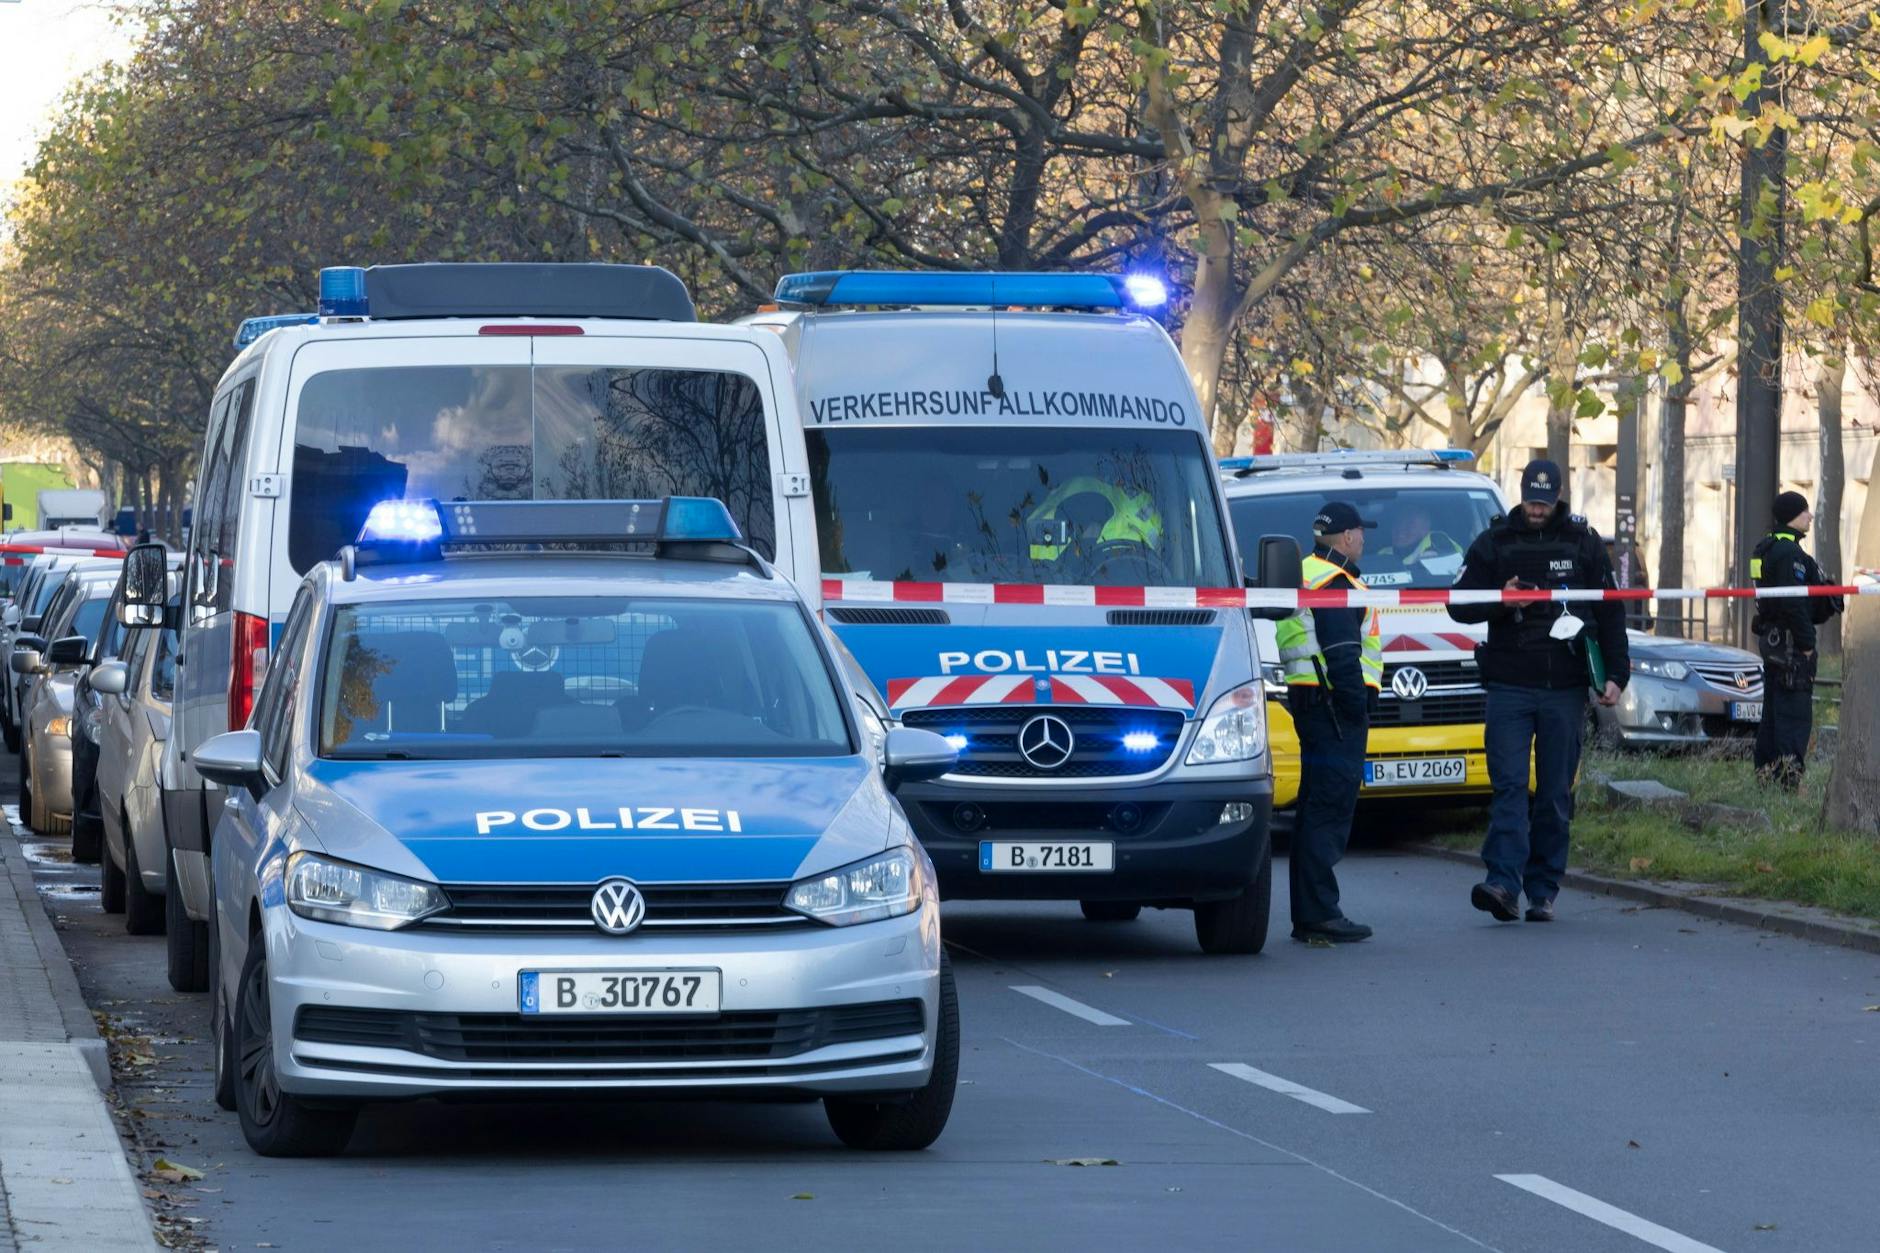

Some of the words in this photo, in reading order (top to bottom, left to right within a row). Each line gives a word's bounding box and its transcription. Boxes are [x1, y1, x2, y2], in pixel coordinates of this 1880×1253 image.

[811, 391, 1186, 426] VERKEHRSUNFALLKOMMANDO
[1530, 481, 1552, 490] POLIZEI
[1549, 560, 1573, 571] POLIZEI
[939, 650, 1141, 675] POLIZEI
[1374, 763, 1385, 780] B
[1396, 761, 1418, 779] EV
[1422, 760, 1462, 778] 2069
[475, 807, 742, 834] POLIZEI
[1011, 846, 1025, 867] B
[1040, 846, 1094, 867] 7181
[557, 977, 577, 1008] B
[601, 976, 701, 1007] 30767
